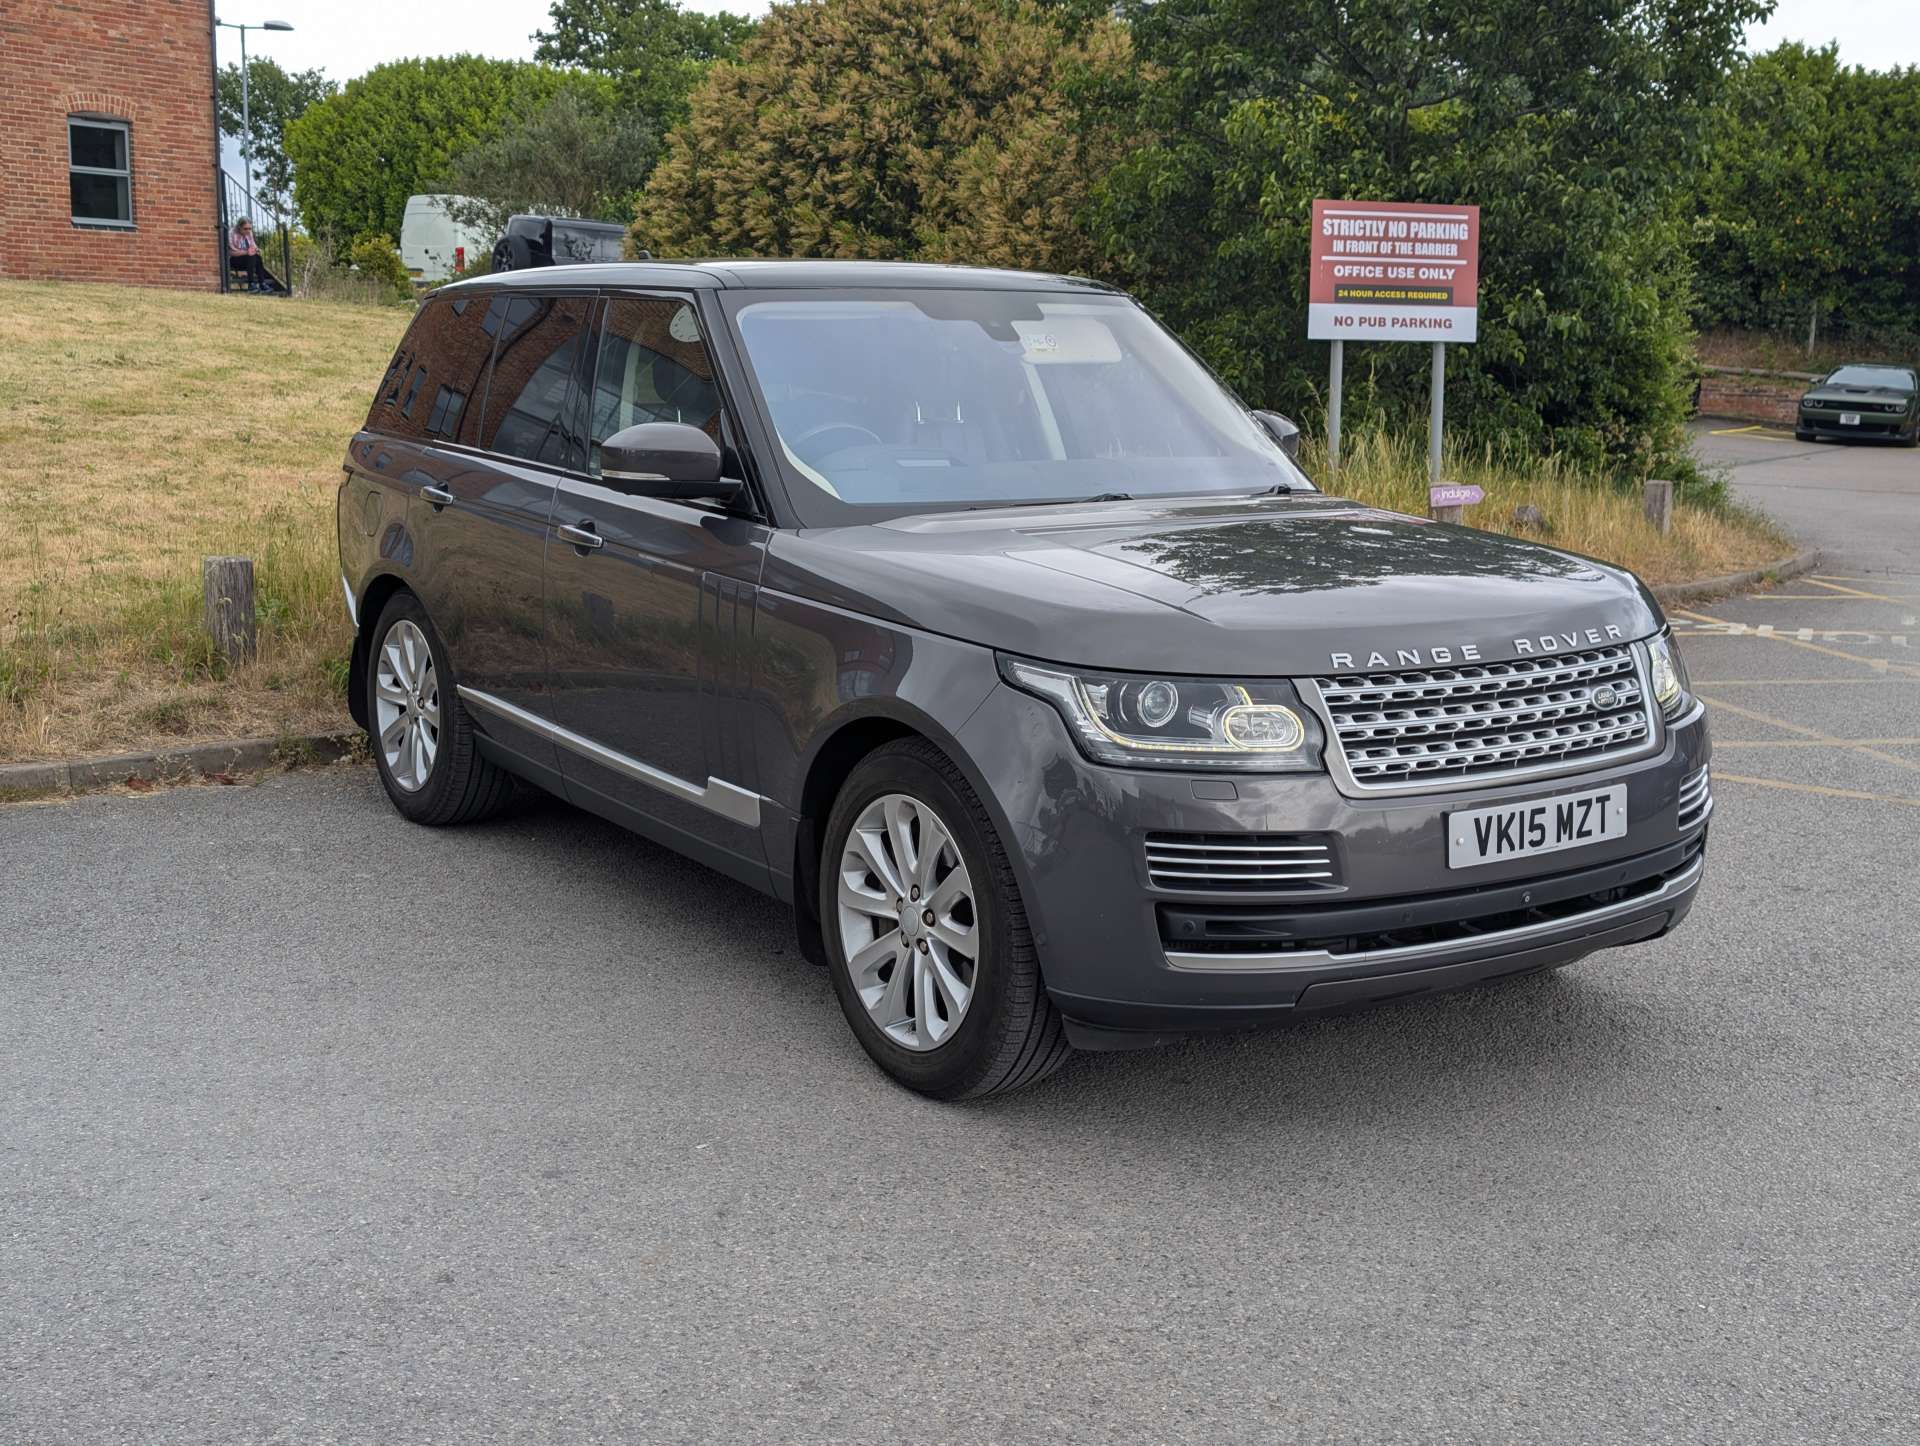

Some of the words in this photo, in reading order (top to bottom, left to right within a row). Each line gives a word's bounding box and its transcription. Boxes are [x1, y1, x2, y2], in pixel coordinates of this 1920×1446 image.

[1323, 218, 1386, 237] STRICTLY
[1388, 220, 1408, 238] NO
[1410, 221, 1469, 240] PARKING
[1333, 240, 1344, 253] IN
[1345, 240, 1379, 254] FRONT
[1380, 241, 1393, 254] OF
[1395, 242, 1414, 255] THE
[1415, 243, 1458, 257] BARRIER
[1333, 265, 1384, 278] OFFICE
[1387, 266, 1415, 279] USE
[1418, 267, 1455, 280] ONLY
[1338, 289, 1349, 297] 24
[1349, 290, 1373, 298] HOUR
[1374, 290, 1406, 299] ACCESS
[1407, 291, 1448, 300] REQUIRED
[1333, 315, 1354, 327] NO
[1358, 316, 1386, 328] PUB
[1391, 317, 1453, 329] PARKING
[1330, 644, 1481, 669] RANGE
[1513, 624, 1623, 654] ROVER
[1473, 806, 1547, 857] VK15
[1556, 793, 1611, 843] MZT
